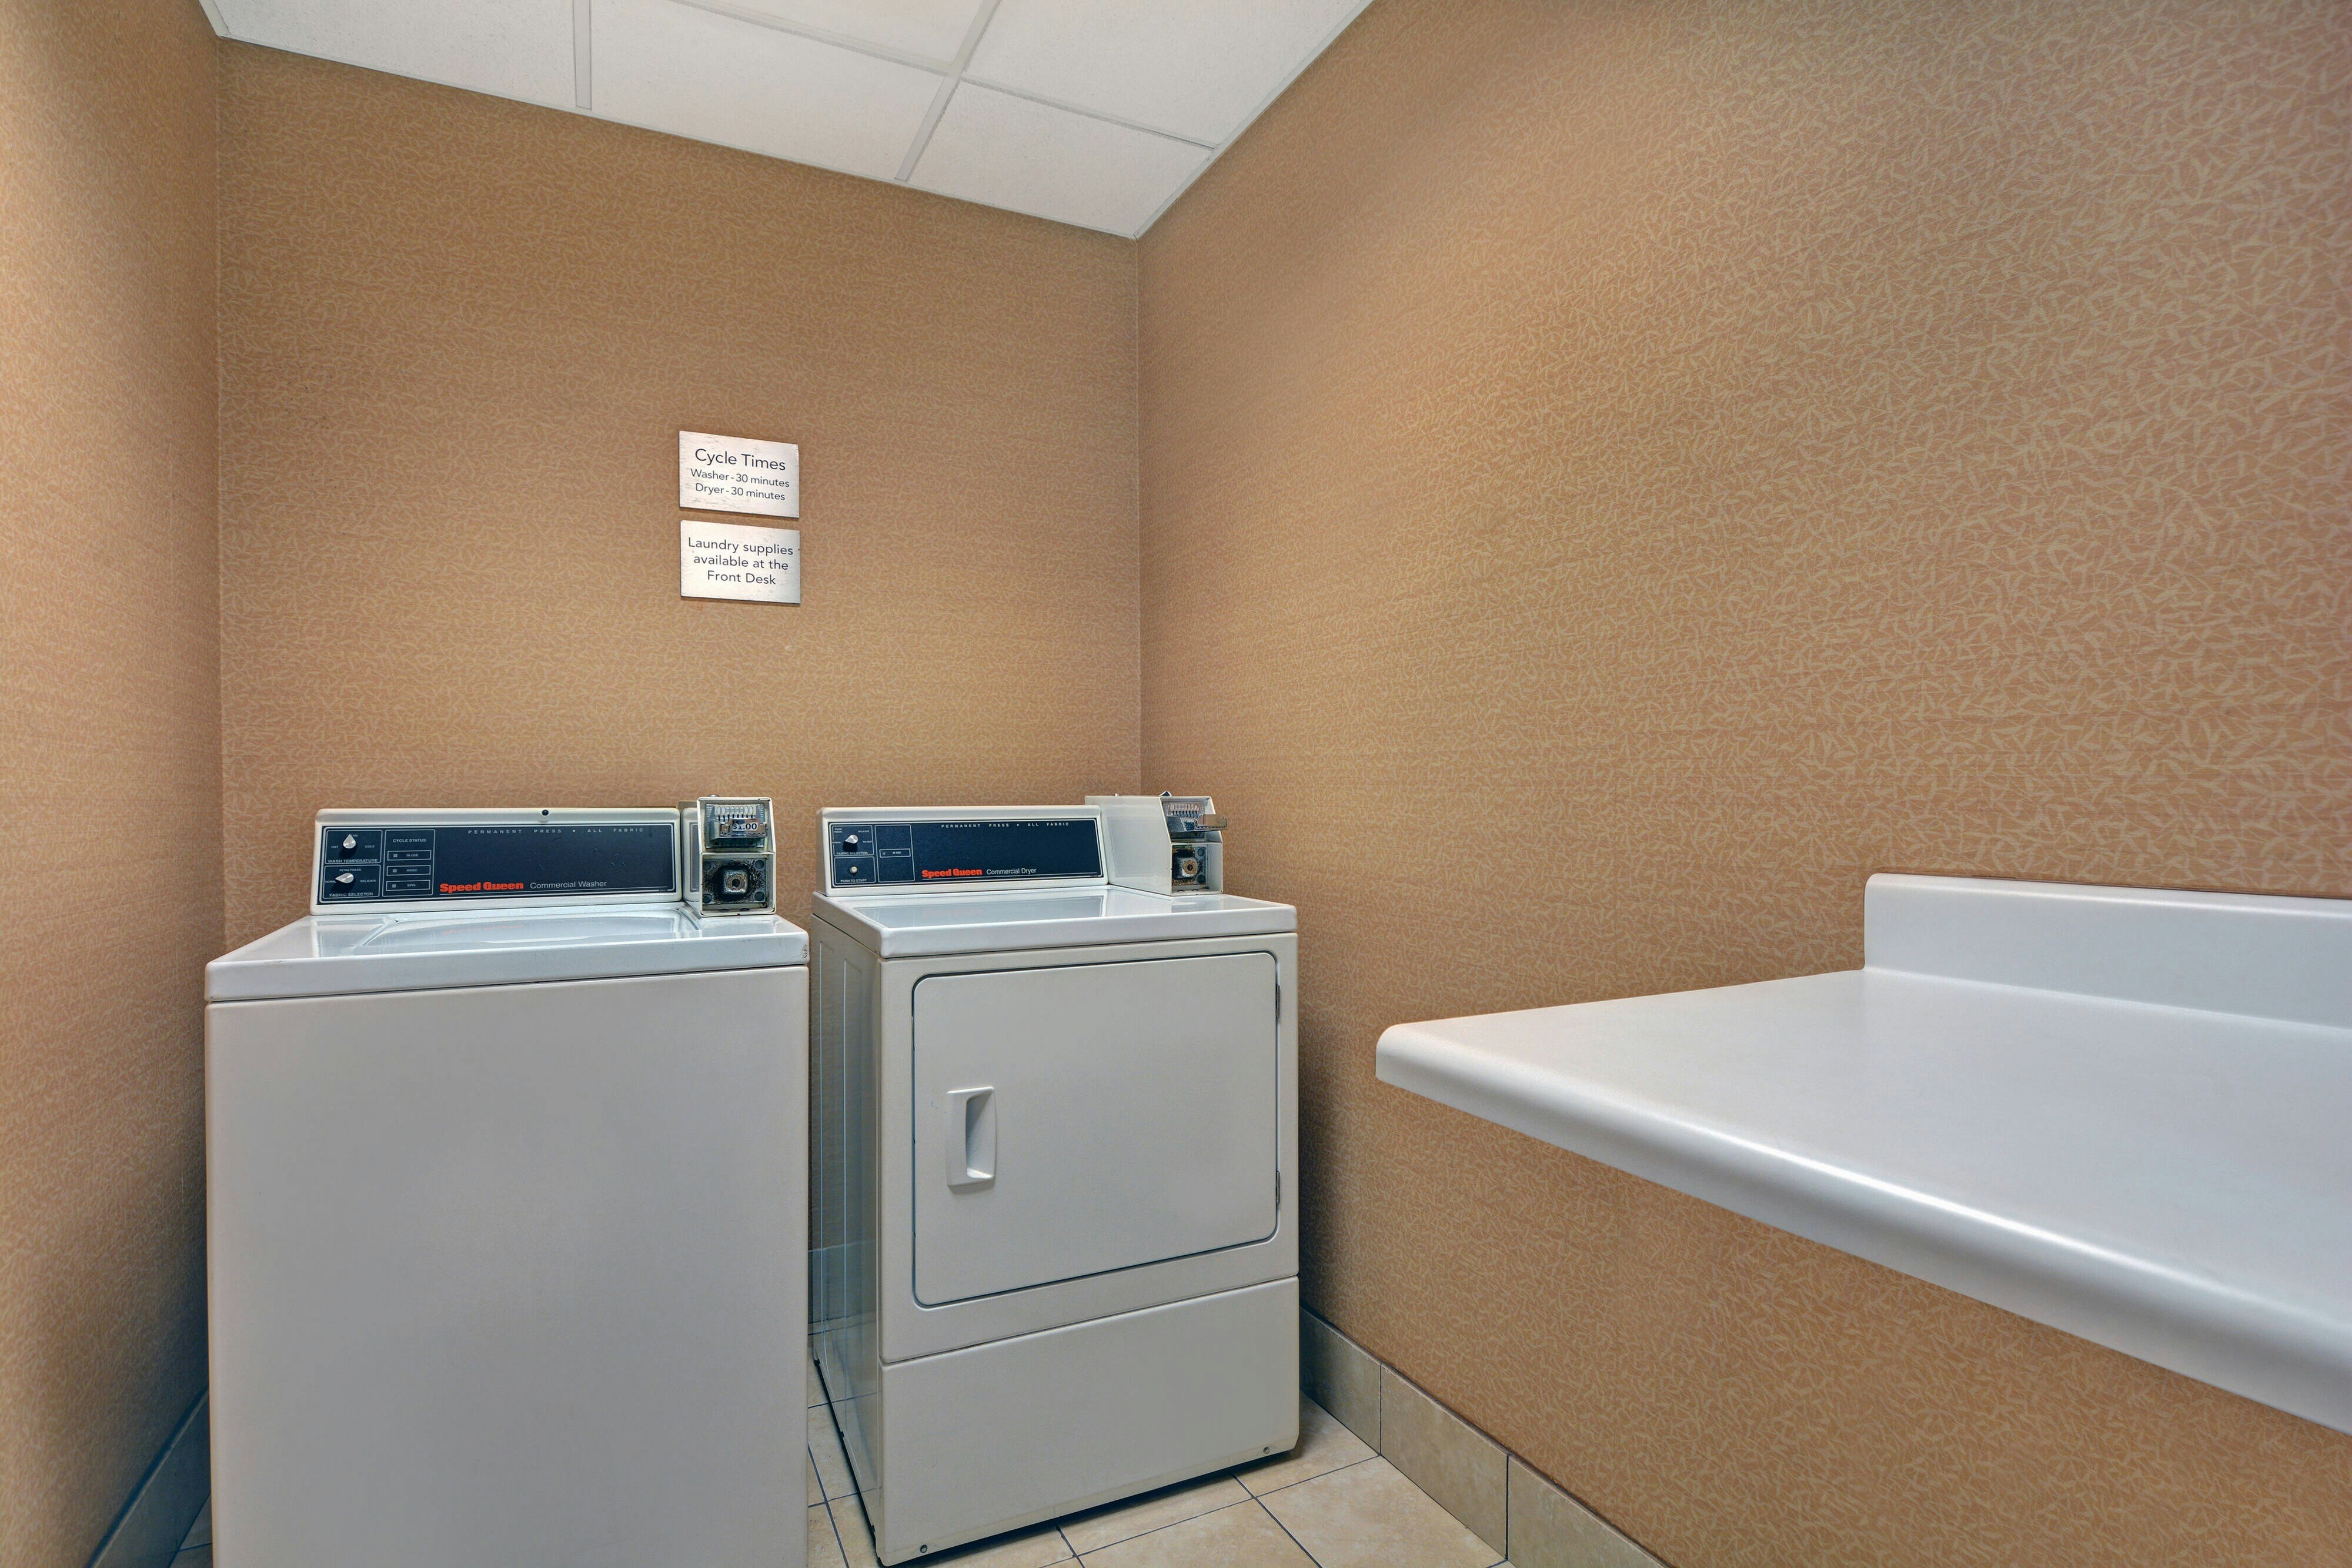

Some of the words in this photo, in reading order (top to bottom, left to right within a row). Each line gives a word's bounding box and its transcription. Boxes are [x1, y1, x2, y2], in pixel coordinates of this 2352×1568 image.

[695, 448, 737, 466] Cycle
[741, 453, 786, 471] Times
[750, 476, 790, 487] minutes
[746, 489, 786, 500] minutes
[688, 537, 739, 554] Laundry
[743, 543, 794, 557] supplies
[693, 554, 749, 567] available
[753, 560, 765, 569] at
[768, 559, 789, 570] the
[707, 570, 741, 583] Front
[746, 573, 776, 585] Desk
[922, 869, 952, 878] Speed
[953, 868, 983, 877] Queen
[440, 882, 481, 893] Speed
[483, 881, 524, 891] Queen
[530, 881, 576, 890] Commercial
[578, 880, 607, 888] Washer
